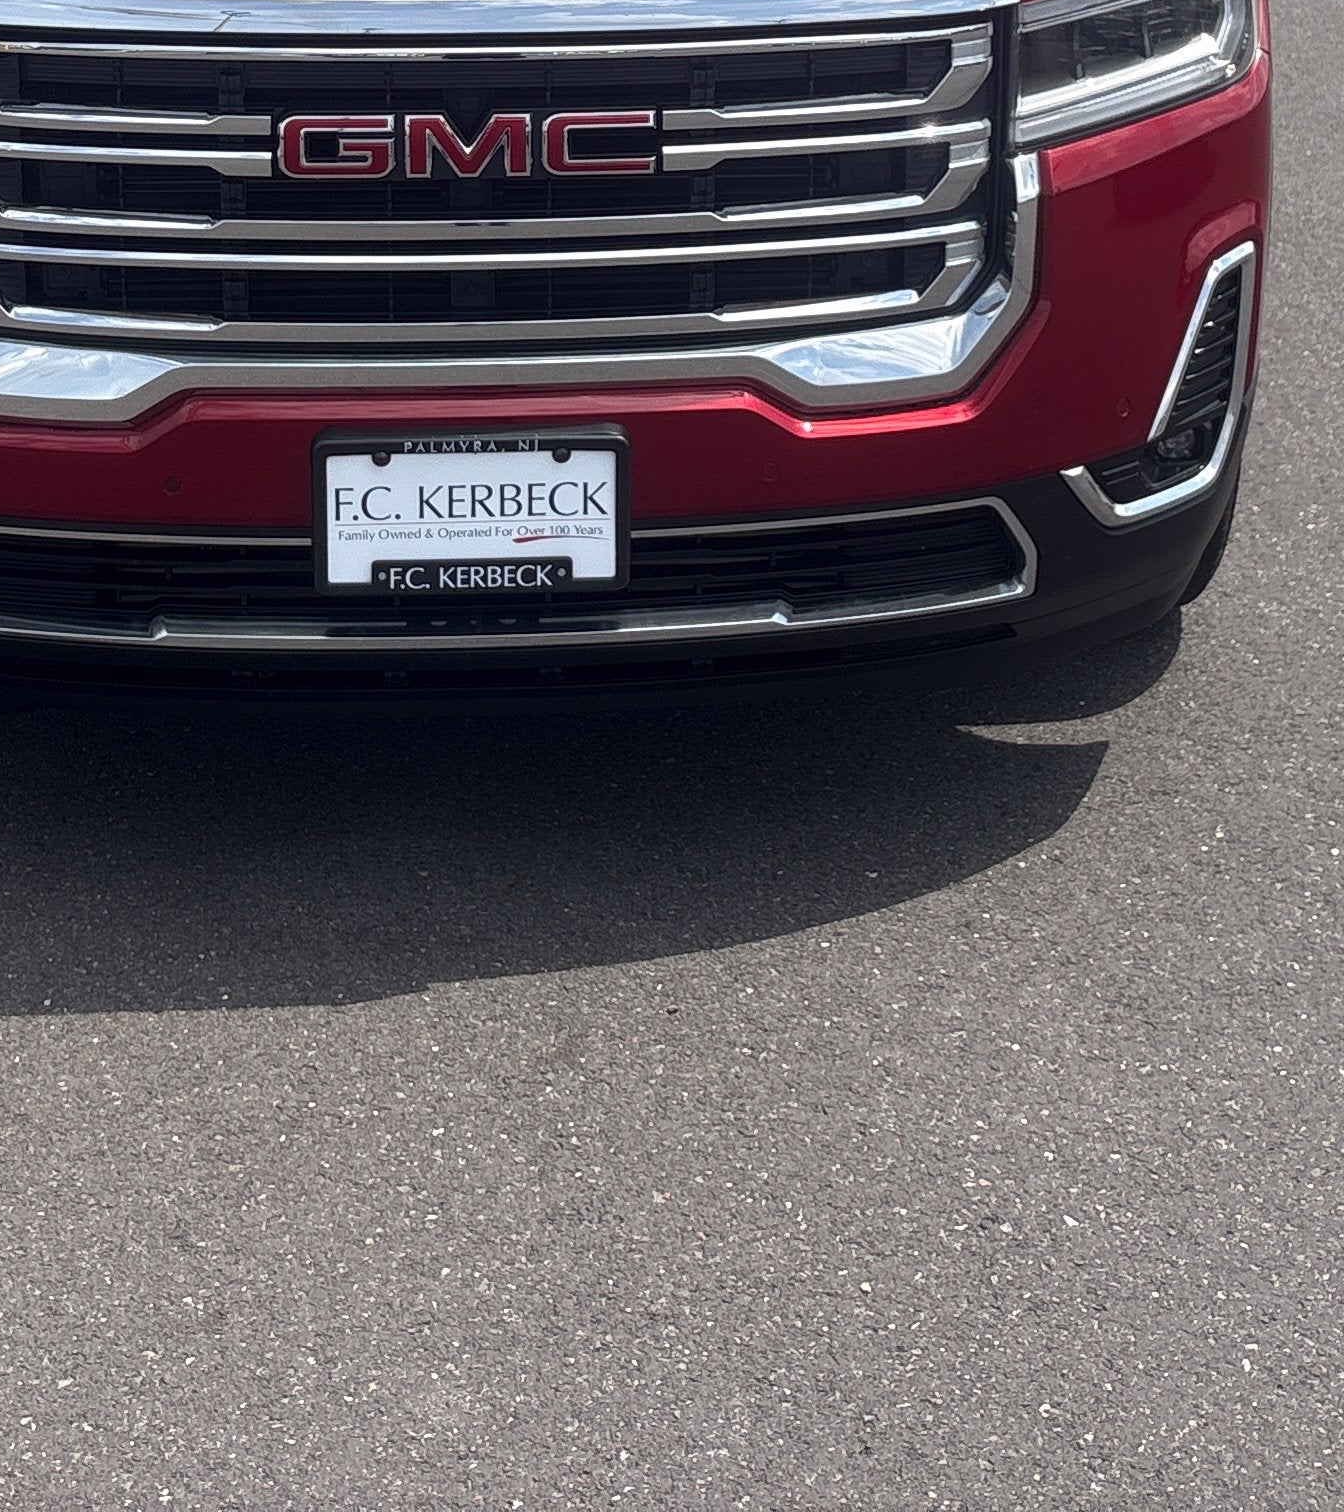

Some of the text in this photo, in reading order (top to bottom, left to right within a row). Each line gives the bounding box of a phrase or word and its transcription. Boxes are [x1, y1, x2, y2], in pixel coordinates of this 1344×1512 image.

[277, 109, 657, 179] GMC
[517, 438, 539, 453] NJ
[334, 481, 609, 522] F.C. KERBECK
[338, 524, 604, 543] Family Owned & Operated For Over 100 Years
[389, 563, 554, 590] F.C. KERBECK
